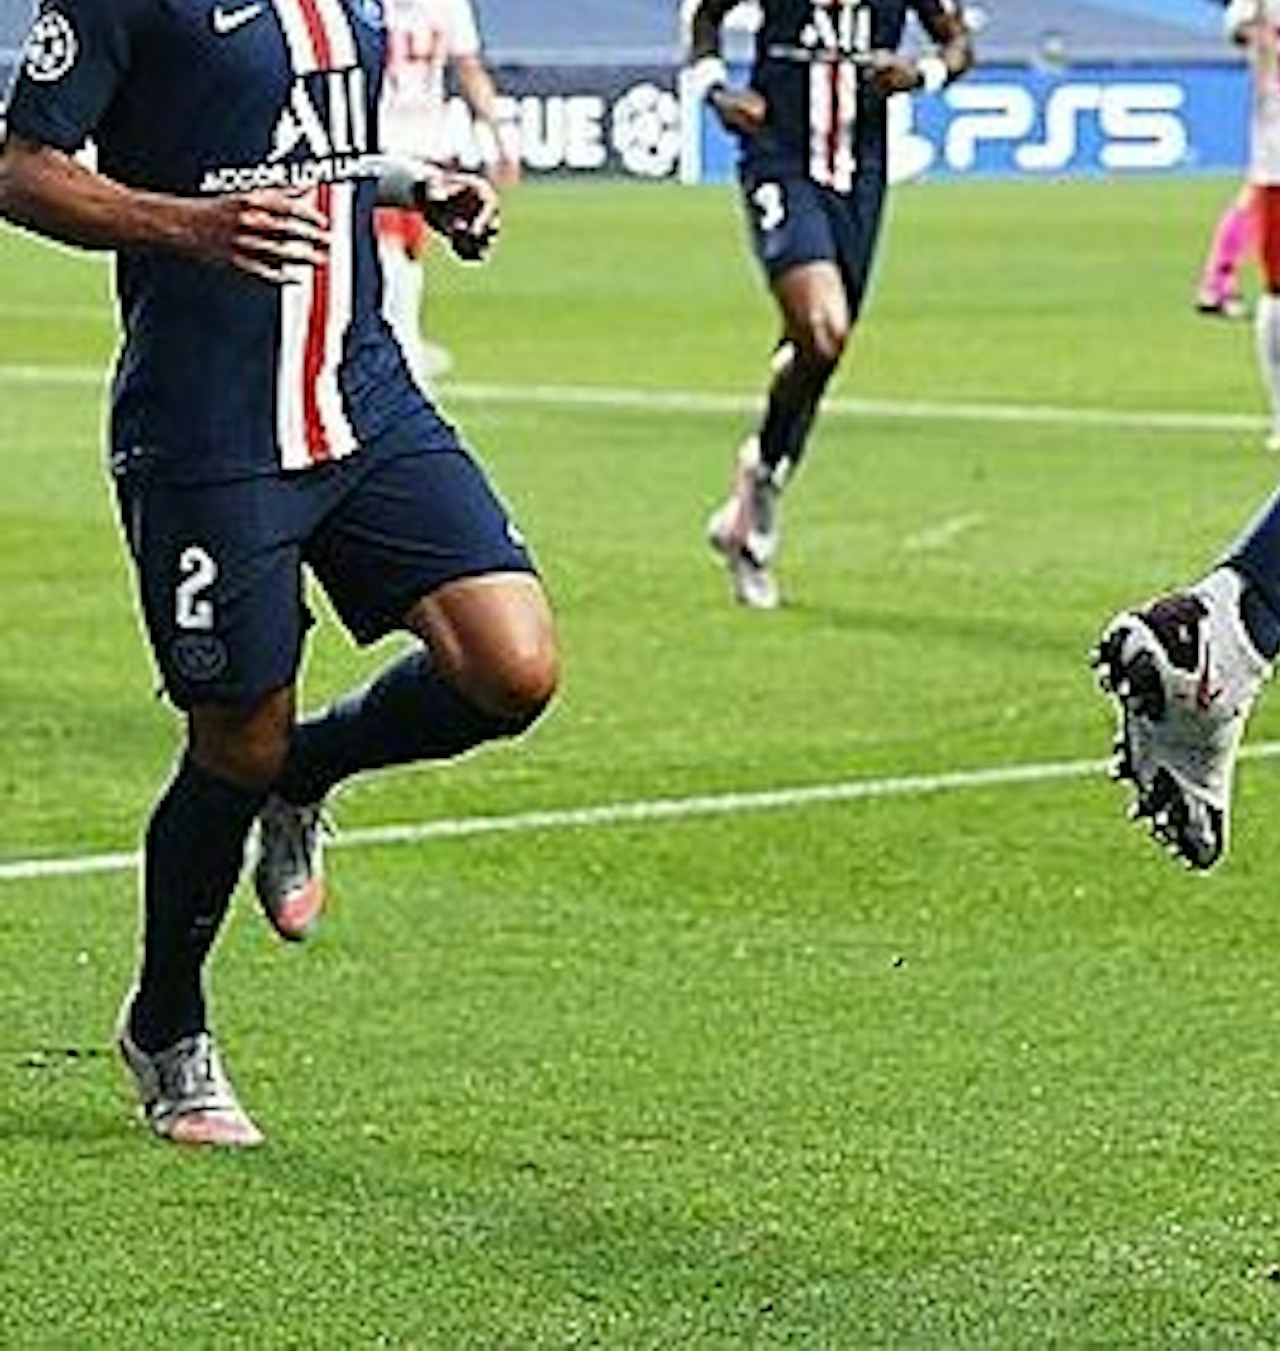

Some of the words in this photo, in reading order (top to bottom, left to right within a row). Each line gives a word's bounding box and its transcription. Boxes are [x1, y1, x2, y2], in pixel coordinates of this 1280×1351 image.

[266, 66, 367, 162] ALL
[944, 83, 1187, 168] PS5
[175, 546, 218, 629] 2
